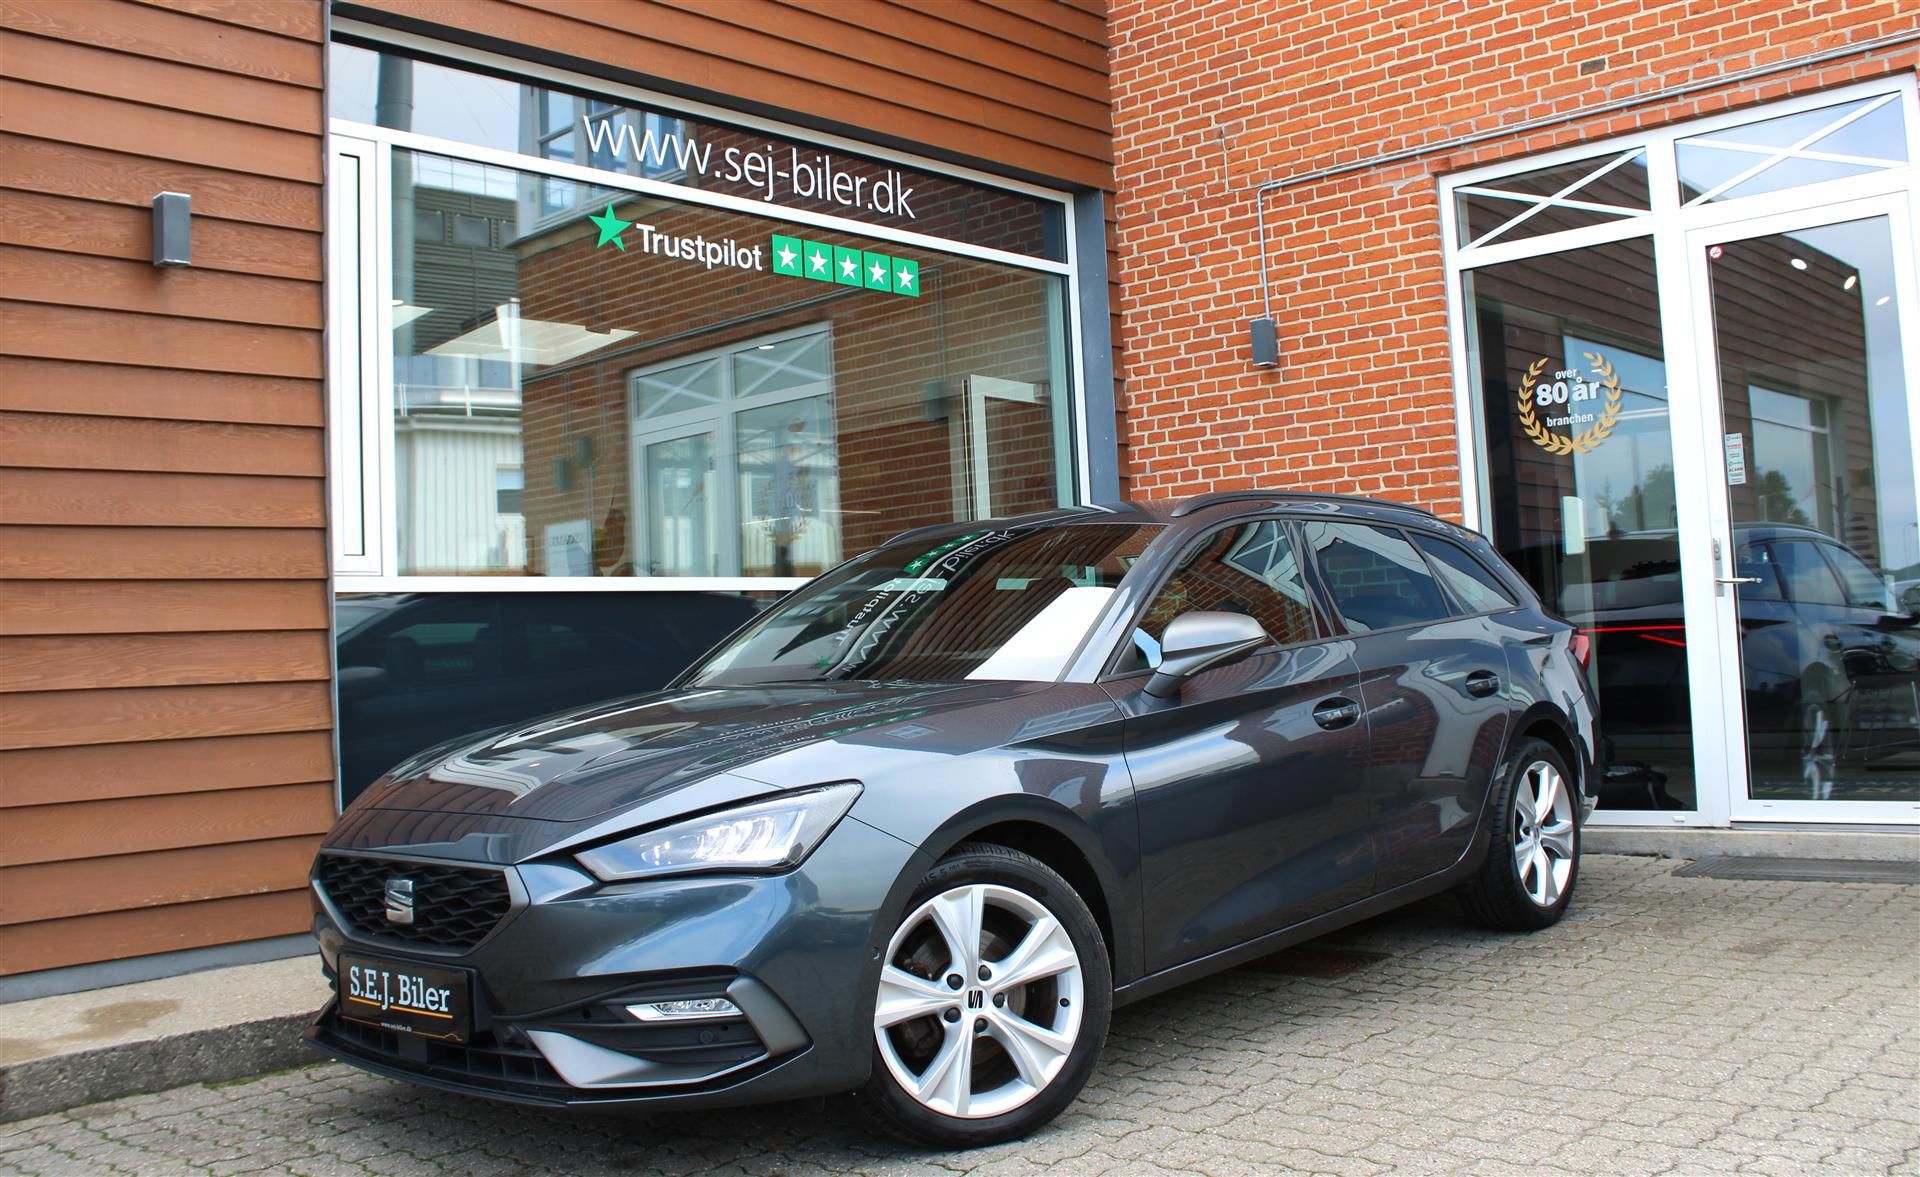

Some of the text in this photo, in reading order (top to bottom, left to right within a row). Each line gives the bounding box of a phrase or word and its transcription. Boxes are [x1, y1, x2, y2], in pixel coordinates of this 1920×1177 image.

[583, 114, 917, 219] www.sej-biler.dk
[636, 222, 763, 272] Trustpilot
[1555, 368, 1578, 380] over
[1536, 376, 1600, 407] 80 år
[1546, 413, 1594, 427] branchen
[1567, 403, 1571, 414] i
[350, 965, 450, 1012] S.E.J. Biler
